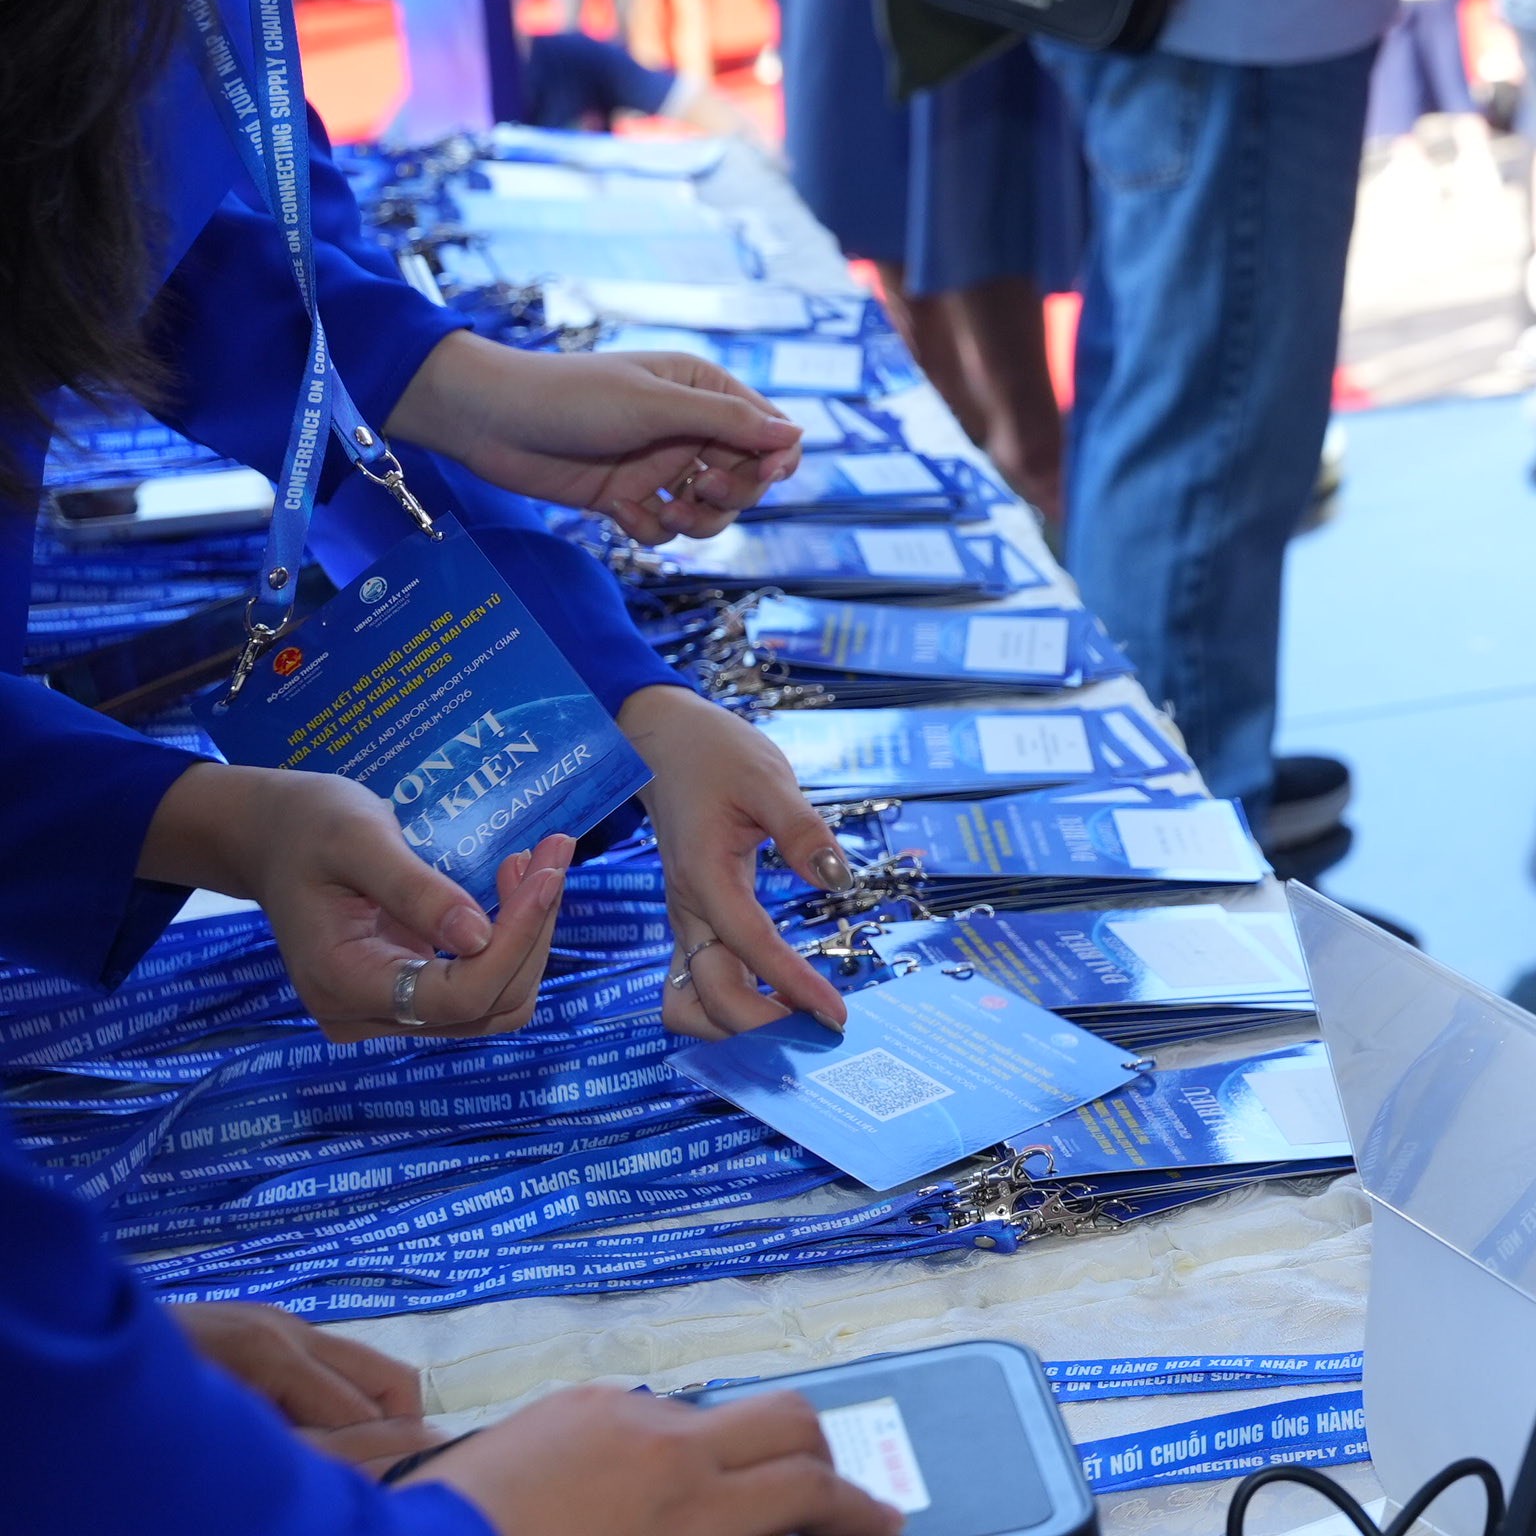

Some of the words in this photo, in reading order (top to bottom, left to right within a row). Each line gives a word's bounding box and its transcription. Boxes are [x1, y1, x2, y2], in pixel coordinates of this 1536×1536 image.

[205, 34, 237, 77] NHẬP
[220, 77, 258, 120] XUẤT
[265, 57, 291, 119] SUPPLY
[271, 123, 299, 225] CONNECTING
[285, 229, 301, 253] ON
[283, 408, 321, 510] CONFERENCE
[307, 379, 325, 404] ON
[353, 615, 373, 633] UBND
[387, 591, 402, 605] TÂY
[401, 578, 420, 595] NINH
[287, 727, 308, 747] HỘI
[305, 707, 335, 732] NGHỊ
[331, 690, 353, 711] KẾT
[352, 675, 373, 695] NỐI
[371, 650, 404, 680] CHUỖI
[402, 628, 432, 654] CUNG
[429, 611, 454, 632] ỨNG
[309, 721, 339, 749] XUẤT
[338, 699, 367, 727] NHẬP
[398, 641, 441, 677] THƯƠNG
[439, 624, 462, 646] MẠI
[459, 605, 487, 629] ĐIỆN
[484, 593, 501, 609] TỬ
[325, 731, 353, 755] TỈNH
[350, 714, 373, 735] TÂY
[372, 693, 401, 719] NINH
[398, 674, 425, 698] NĂM
[423, 652, 453, 679] 2026
[335, 740, 378, 779] OMMERCE
[378, 726, 396, 745] AND
[394, 671, 464, 730] EXPORT-IMPORT
[463, 647, 495, 676] SUPPLY
[494, 627, 521, 651] CHAIN
[408, 711, 443, 741] FORUM
[441, 688, 473, 715] 2026
[451, 708, 506, 749] VỊ
[435, 730, 540, 825] KIỆN
[448, 744, 592, 860] ORGANIZER
[643, 922, 665, 941] ON
[559, 996, 589, 1018] NỐI
[594, 984, 622, 1008] KẾT
[95, 1020, 124, 1047] AND
[287, 1043, 322, 1069] XUẤT
[584, 1060, 673, 1098] CONNECTING
[453, 1093, 513, 1116] CHAINS
[520, 1082, 581, 1106] SUPPLY
[358, 1100, 415, 1119] GOODS,
[419, 1098, 449, 1117] FOR
[546, 1105, 645, 1127] CONNECTING
[220, 1104, 352, 1143] IMPORT-EXPORT
[180, 1126, 214, 1150] AND
[317, 1138, 365, 1157] NHẬP
[687, 1139, 710, 1161] ON
[584, 1146, 683, 1183] CONNECTING
[254, 1166, 393, 1207] IMPORT-EXPORT
[520, 1168, 581, 1200] SUPPLY
[450, 1185, 515, 1217] CHAINS
[542, 1194, 581, 1220] ỨNG
[584, 1189, 632, 1208] CUNG
[635, 1188, 689, 1206] CHUỖI
[165, 1218, 197, 1232] TAY
[413, 1206, 449, 1229] FOR
[490, 1210, 538, 1237] HÀNG
[788, 1204, 893, 1237] CONFERENCE
[115, 1222, 160, 1240] NINH
[236, 1212, 380, 1251] IMPORT-EXPORT
[340, 1221, 410, 1246] GOODS,
[446, 1228, 485, 1247] HOÁ
[762, 1232, 786, 1245] ON
[193, 1240, 340, 1273] IMPORT-EXPORT
[197, 1246, 237, 1261] AND
[345, 1254, 395, 1268] NHẬP
[400, 1250, 448, 1268] XUẤT
[453, 1248, 490, 1260] HOÁ
[652, 1241, 757, 1265] CONNECTING
[511, 1264, 576, 1283] CHAINS
[582, 1259, 648, 1275] SUPPLY
[205, 1287, 240, 1302] MẠI
[473, 1273, 506, 1293] FOR
[402, 1289, 468, 1306] GOODS,
[1065, 1362, 1103, 1377] ỨNG
[1109, 1360, 1158, 1376] HÀNG
[1164, 1357, 1202, 1370] HOÁ
[1260, 1358, 1309, 1371] NHẬP
[1081, 1454, 1103, 1482] ẾT
[1110, 1444, 1143, 1476] NỐI
[1150, 1429, 1207, 1467] CHUỖI
[1213, 1423, 1264, 1451] CUNG
[1270, 1414, 1310, 1440] ỨNG
[1316, 1405, 1366, 1435] HÀNG
[1269, 1447, 1338, 1466] SUPPLY
